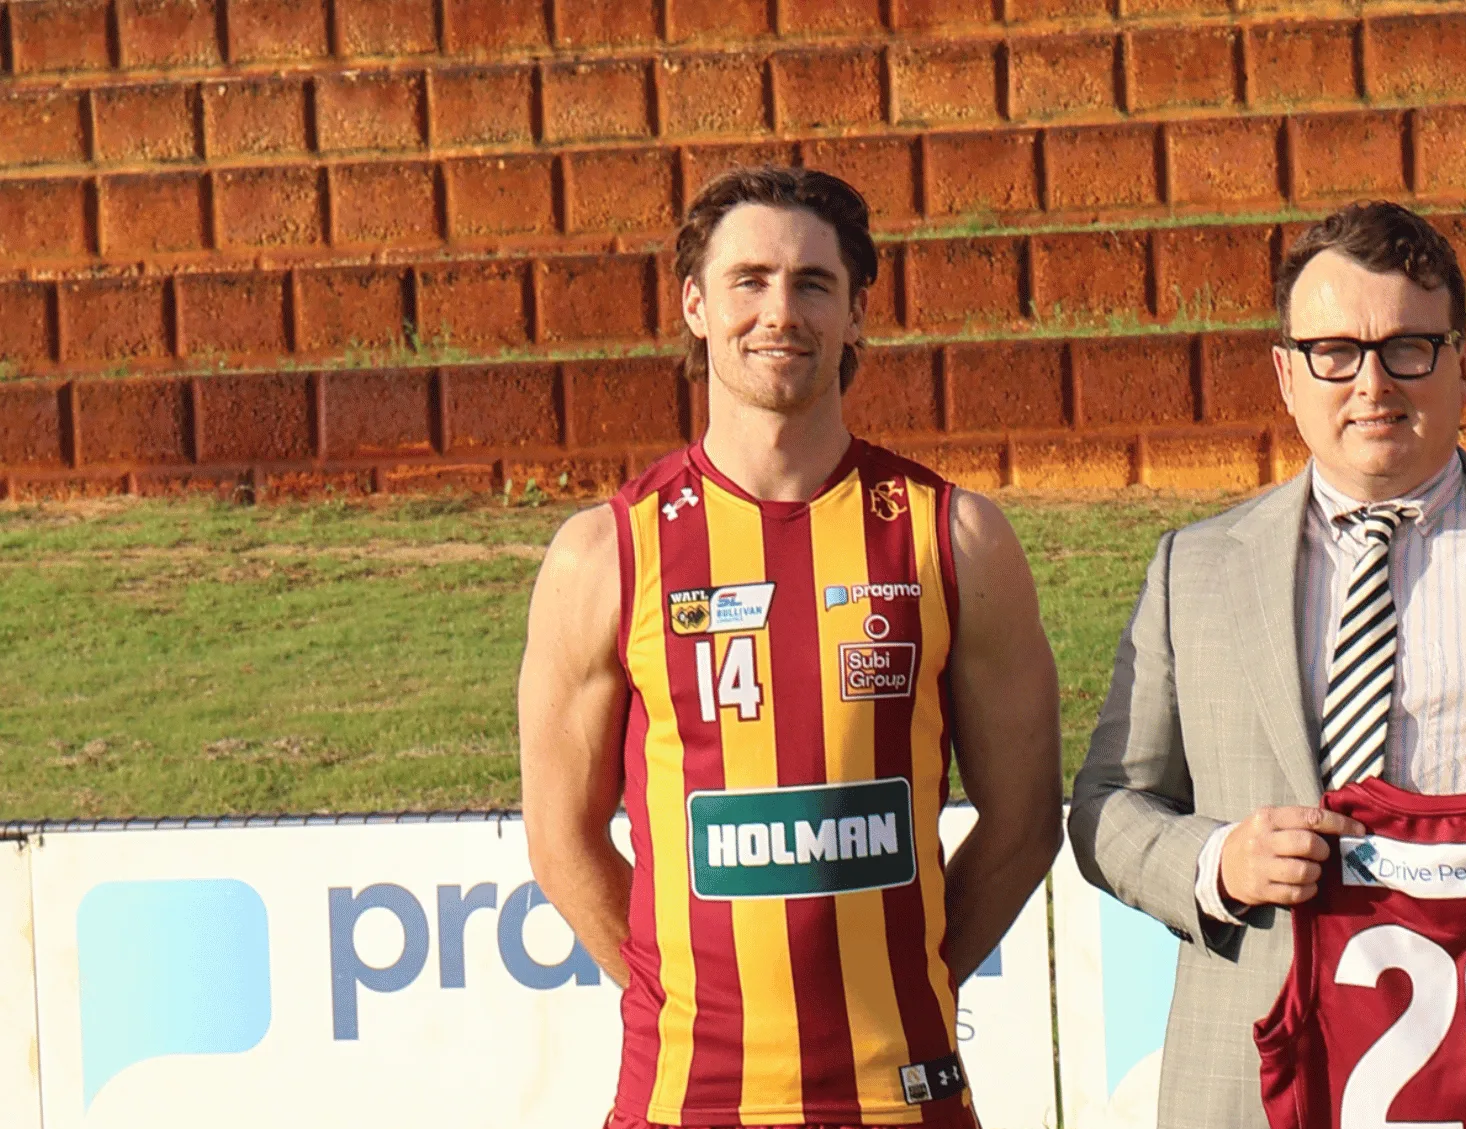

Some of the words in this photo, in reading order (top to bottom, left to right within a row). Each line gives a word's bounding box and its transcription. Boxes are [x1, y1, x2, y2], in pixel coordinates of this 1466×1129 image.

[852, 583, 921, 603] pragma
[848, 650, 890, 671] Subi
[695, 636, 762, 722] 14
[849, 670, 906, 690] Group
[706, 812, 899, 868] HOLMAN
[1378, 857, 1433, 881] Drive
